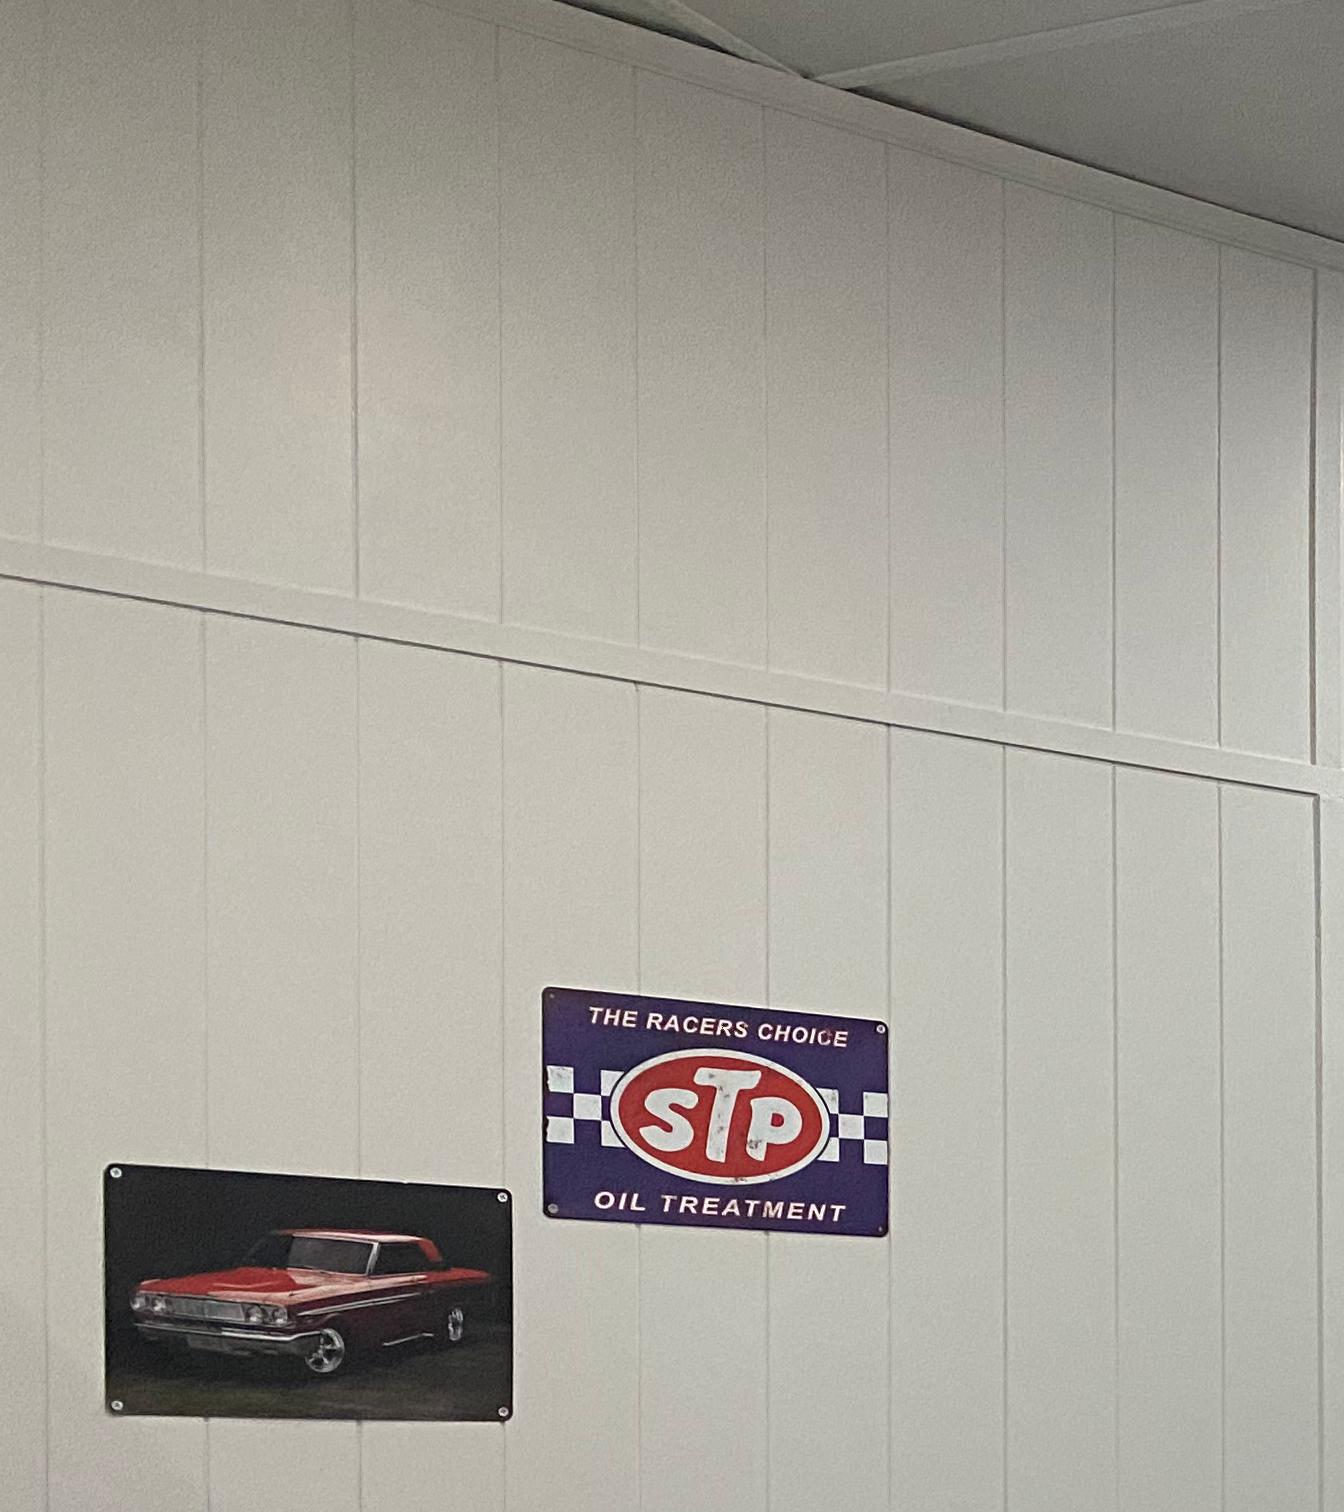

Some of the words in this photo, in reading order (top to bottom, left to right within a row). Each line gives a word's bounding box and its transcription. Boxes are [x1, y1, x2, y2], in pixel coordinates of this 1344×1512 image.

[589, 1006, 638, 1028] THE
[646, 1013, 748, 1038] RACERS
[757, 1023, 849, 1047] CHOICE
[639, 1066, 803, 1164] STP
[594, 1191, 646, 1212] OIL
[661, 1194, 847, 1222] TREATMENT
